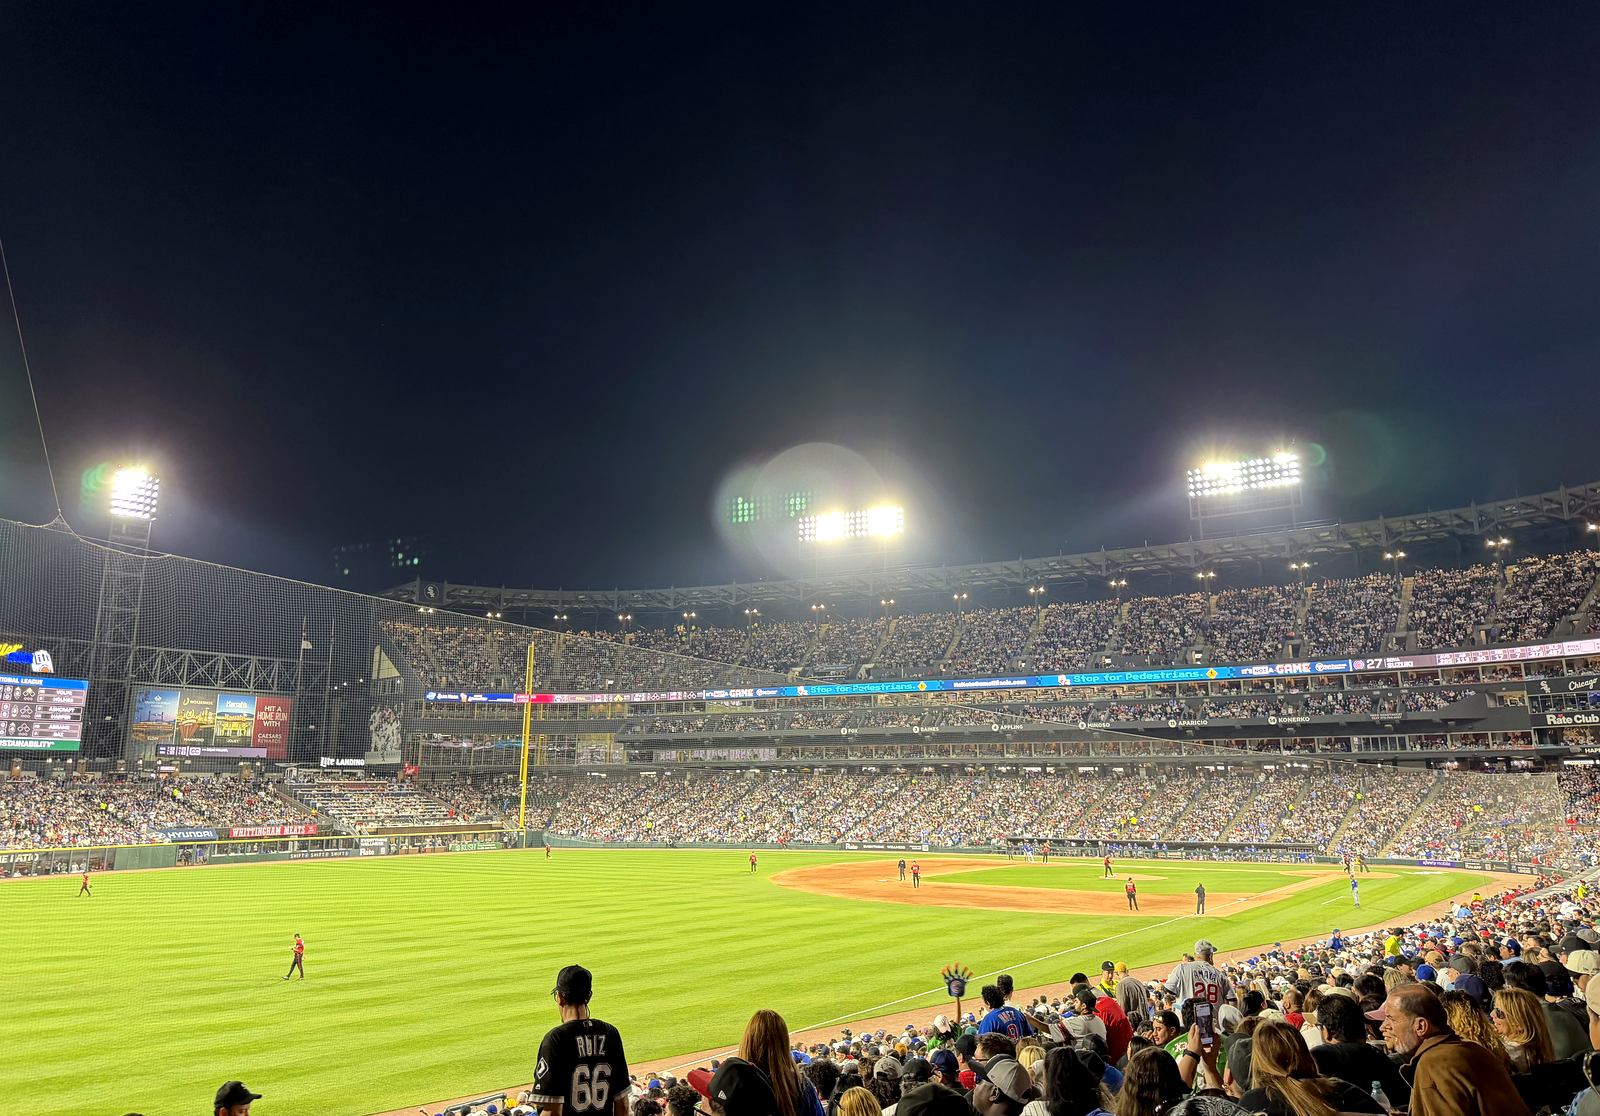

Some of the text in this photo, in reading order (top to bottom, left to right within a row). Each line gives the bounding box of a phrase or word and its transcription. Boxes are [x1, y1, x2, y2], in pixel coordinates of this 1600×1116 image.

[1275, 662, 1311, 673] GAME
[1366, 658, 1382, 669] 27
[1073, 675, 1099, 683] Stop
[1125, 671, 1204, 681] Pedestrians.
[810, 686, 833, 694] Stop
[853, 683, 916, 692] Pedestrians.
[1568, 677, 1598, 690] Chicago
[257, 711, 288, 721] HOME RUN
[1546, 713, 1599, 725] Rate Club
[335, 758, 365, 767] LANDING
[167, 830, 213, 838] HYUNDAI
[232, 824, 306, 837] WHITTINGHAM MEATS
[1193, 969, 1217, 981] AMAYA
[1194, 981, 1218, 1004] 28
[576, 1035, 606, 1058] RUIZ
[571, 1062, 612, 1112] 66
